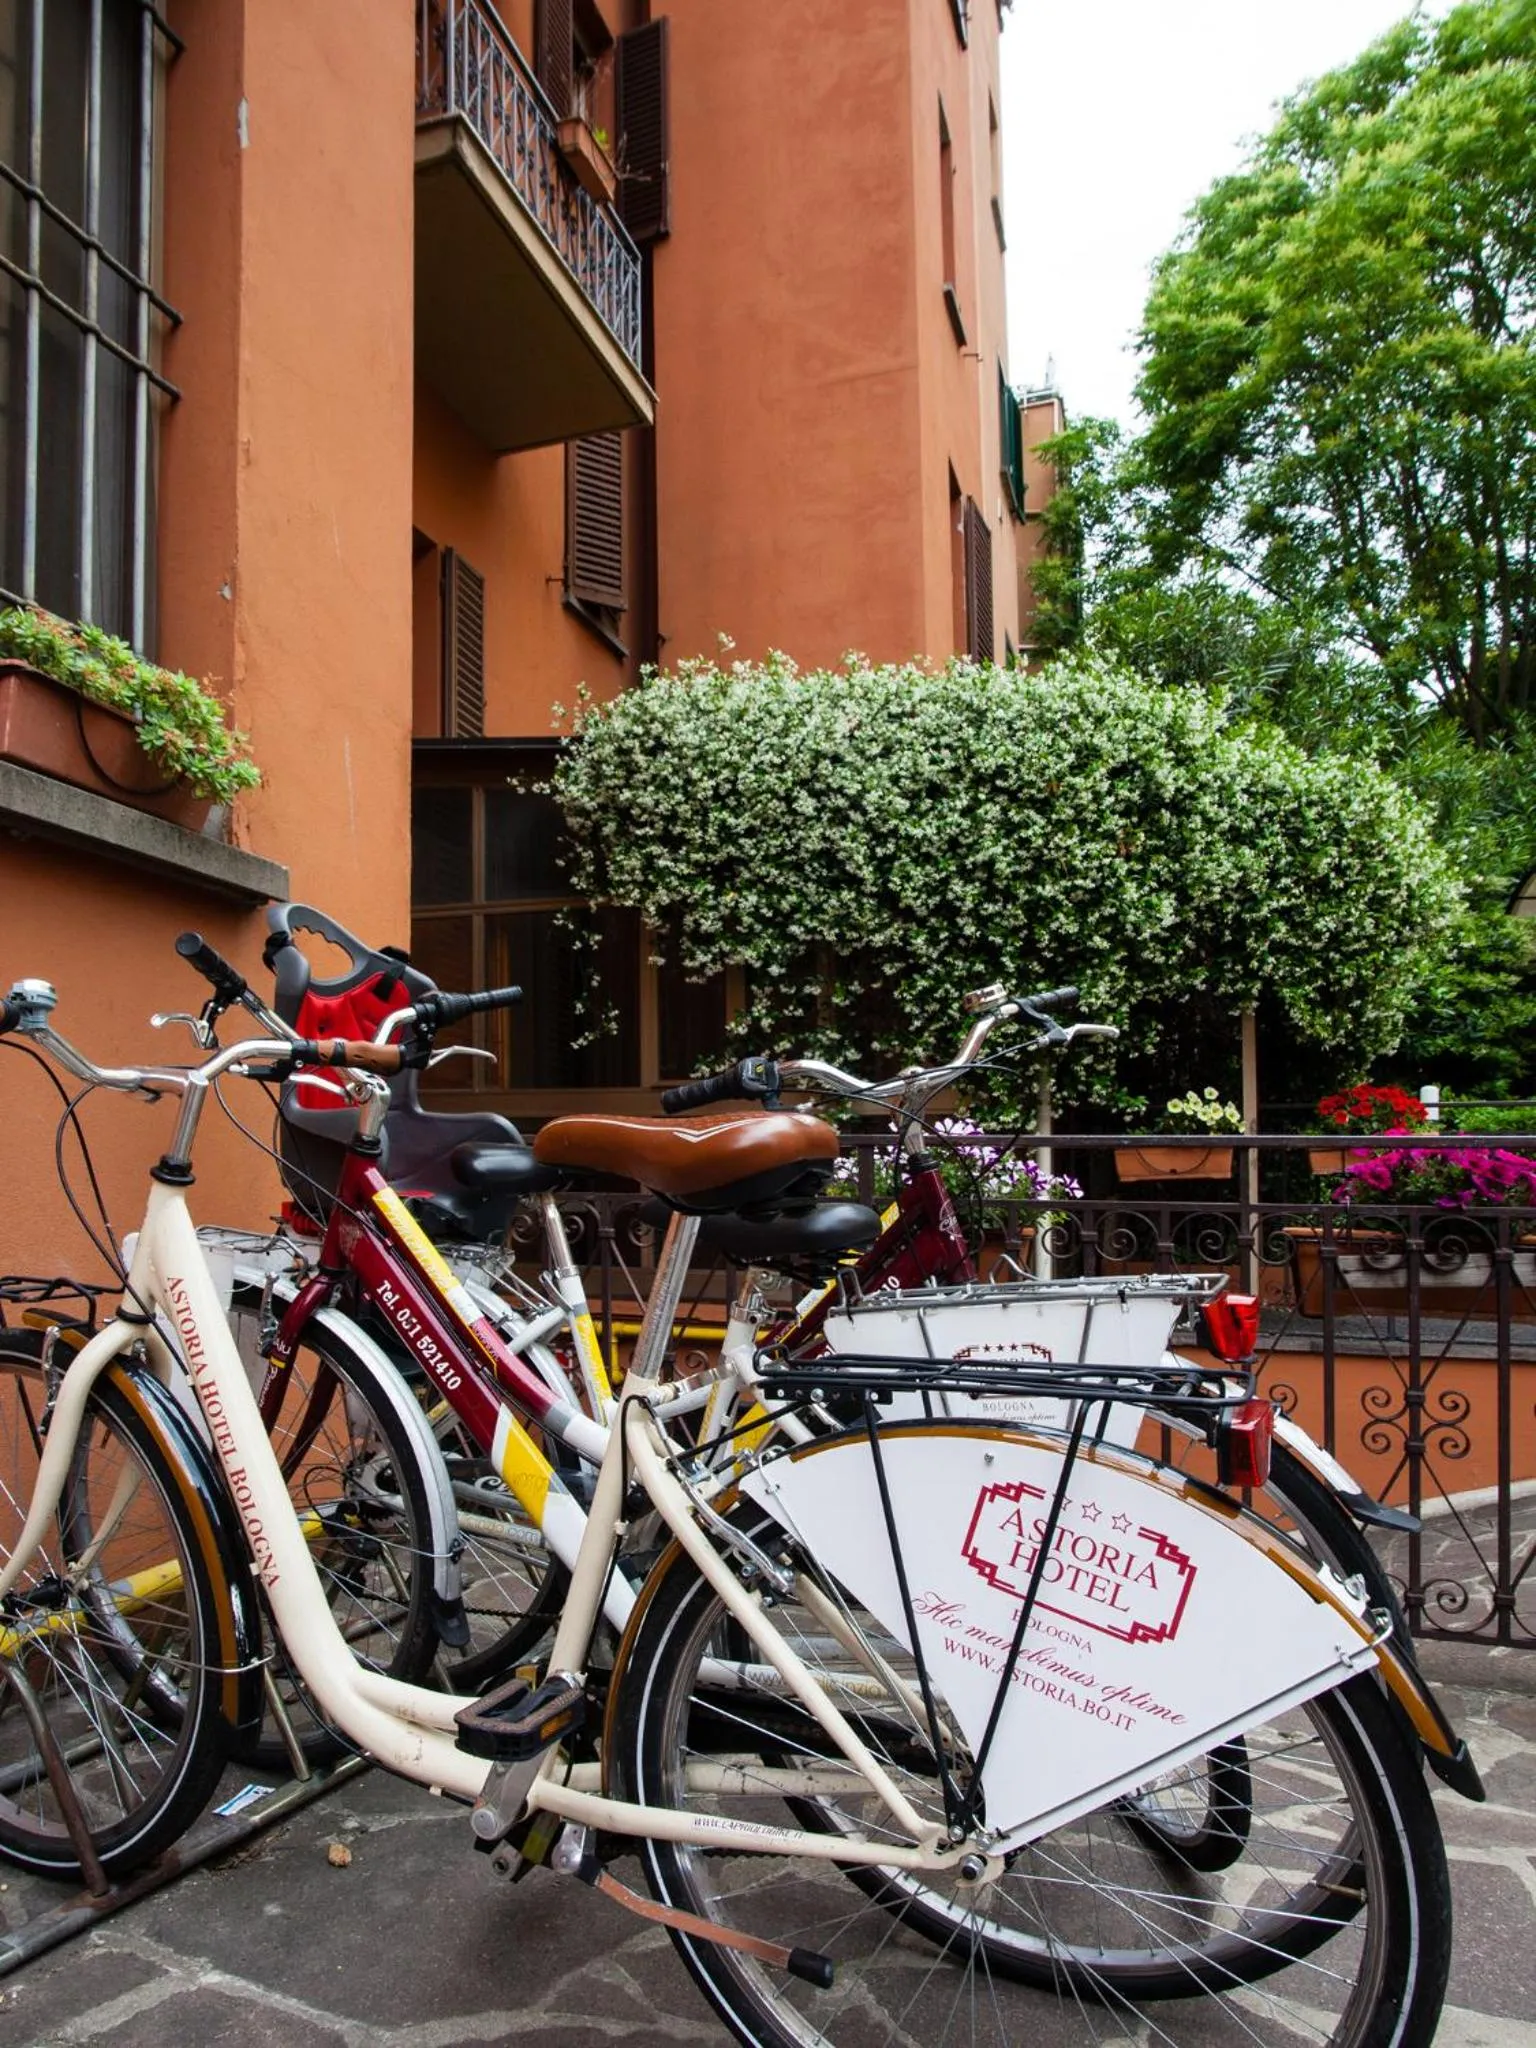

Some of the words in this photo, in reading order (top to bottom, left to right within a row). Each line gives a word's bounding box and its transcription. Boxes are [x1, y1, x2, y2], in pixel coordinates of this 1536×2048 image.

[376, 1280, 400, 1310] Tel.
[396, 1308, 421, 1338] 051
[416, 1335, 462, 1390] 521410
[166, 1277, 208, 1376] ASTORIA
[200, 1381, 236, 1464] HOTEL
[229, 1467, 281, 1588] BOLOGNA
[982, 1401, 1035, 1412] BOLOGNA
[999, 1508, 1158, 1590] ASTORIA
[1008, 1540, 1131, 1613] HOTEL
[910, 1591, 967, 1629] Hic
[1100, 1684, 1188, 1725] optime
